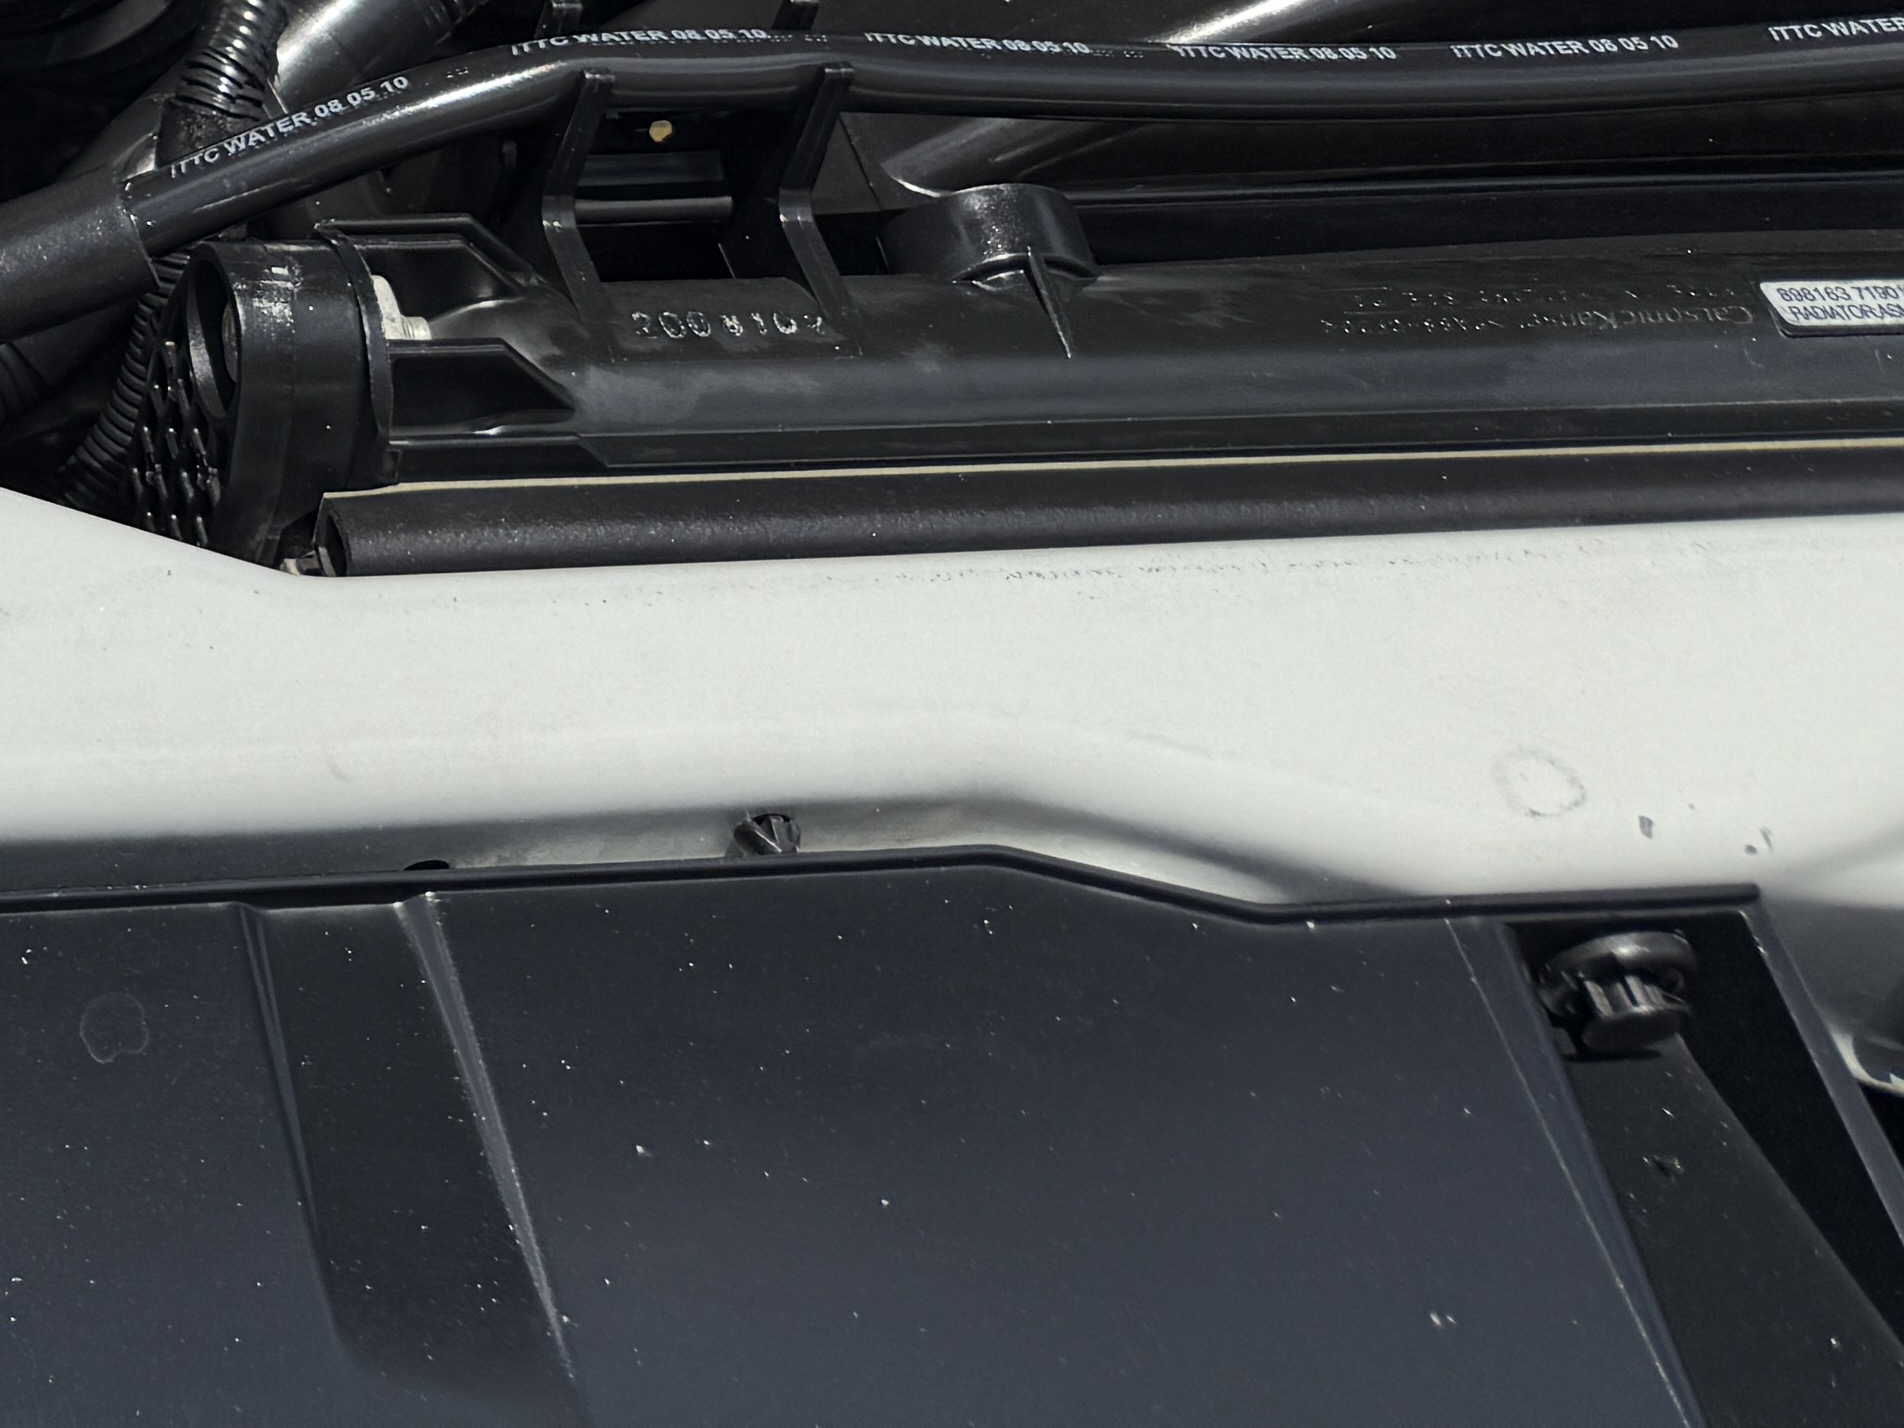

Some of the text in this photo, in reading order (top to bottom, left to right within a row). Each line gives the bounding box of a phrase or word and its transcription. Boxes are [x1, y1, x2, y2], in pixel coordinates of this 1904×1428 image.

[511, 28, 769, 56] ITTC WATER 08 05 10
[864, 32, 1091, 54] ITTC WATER 08 05 10
[1768, 23, 1822, 41] ITTC
[1172, 43, 1397, 60] ITTC WATER 08 05 10
[1450, 34, 1679, 59] ITTC WATER 08 05 10
[170, 76, 409, 179] ITTC WATER 08 05 10
[1776, 285, 1852, 302] 898163
